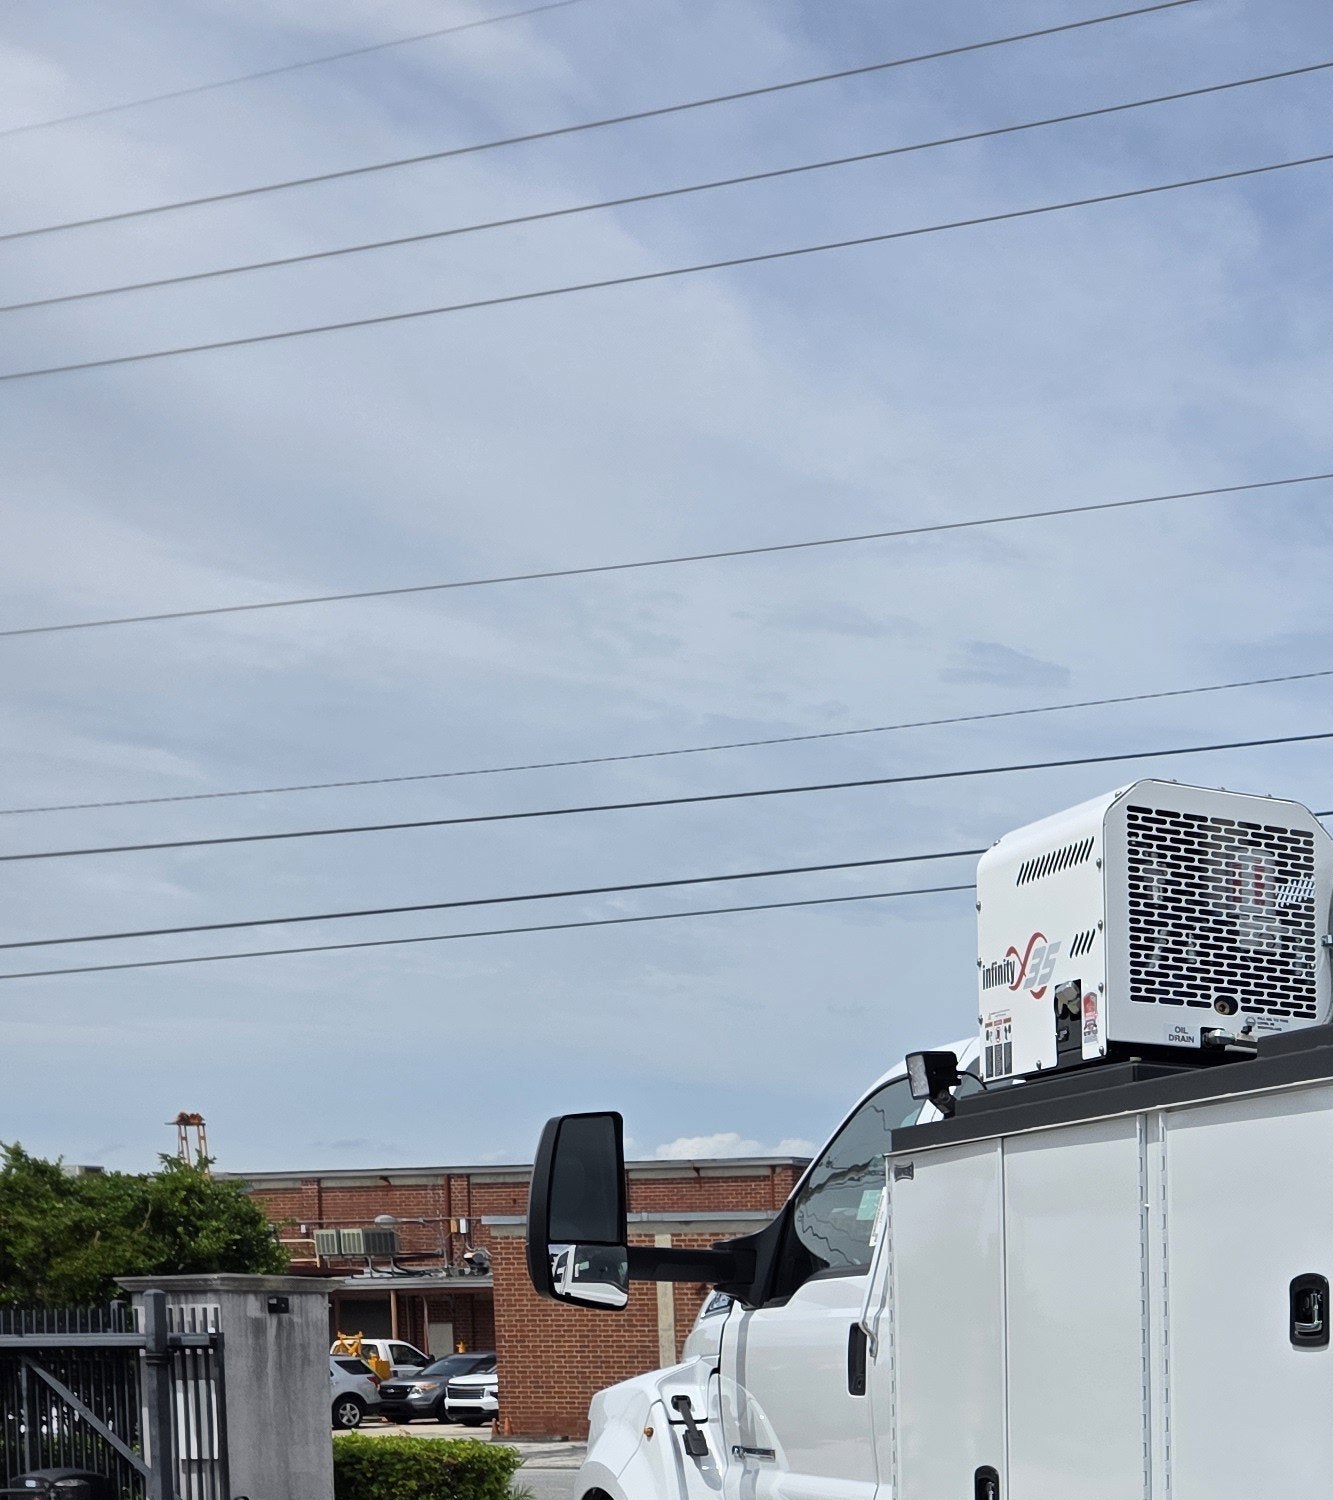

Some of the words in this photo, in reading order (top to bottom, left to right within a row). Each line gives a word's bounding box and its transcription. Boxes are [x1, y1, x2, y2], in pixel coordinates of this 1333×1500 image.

[982, 959, 1015, 990] infinity
[1174, 1026, 1189, 1034] OIL
[1168, 1033, 1195, 1043] DRAIN
